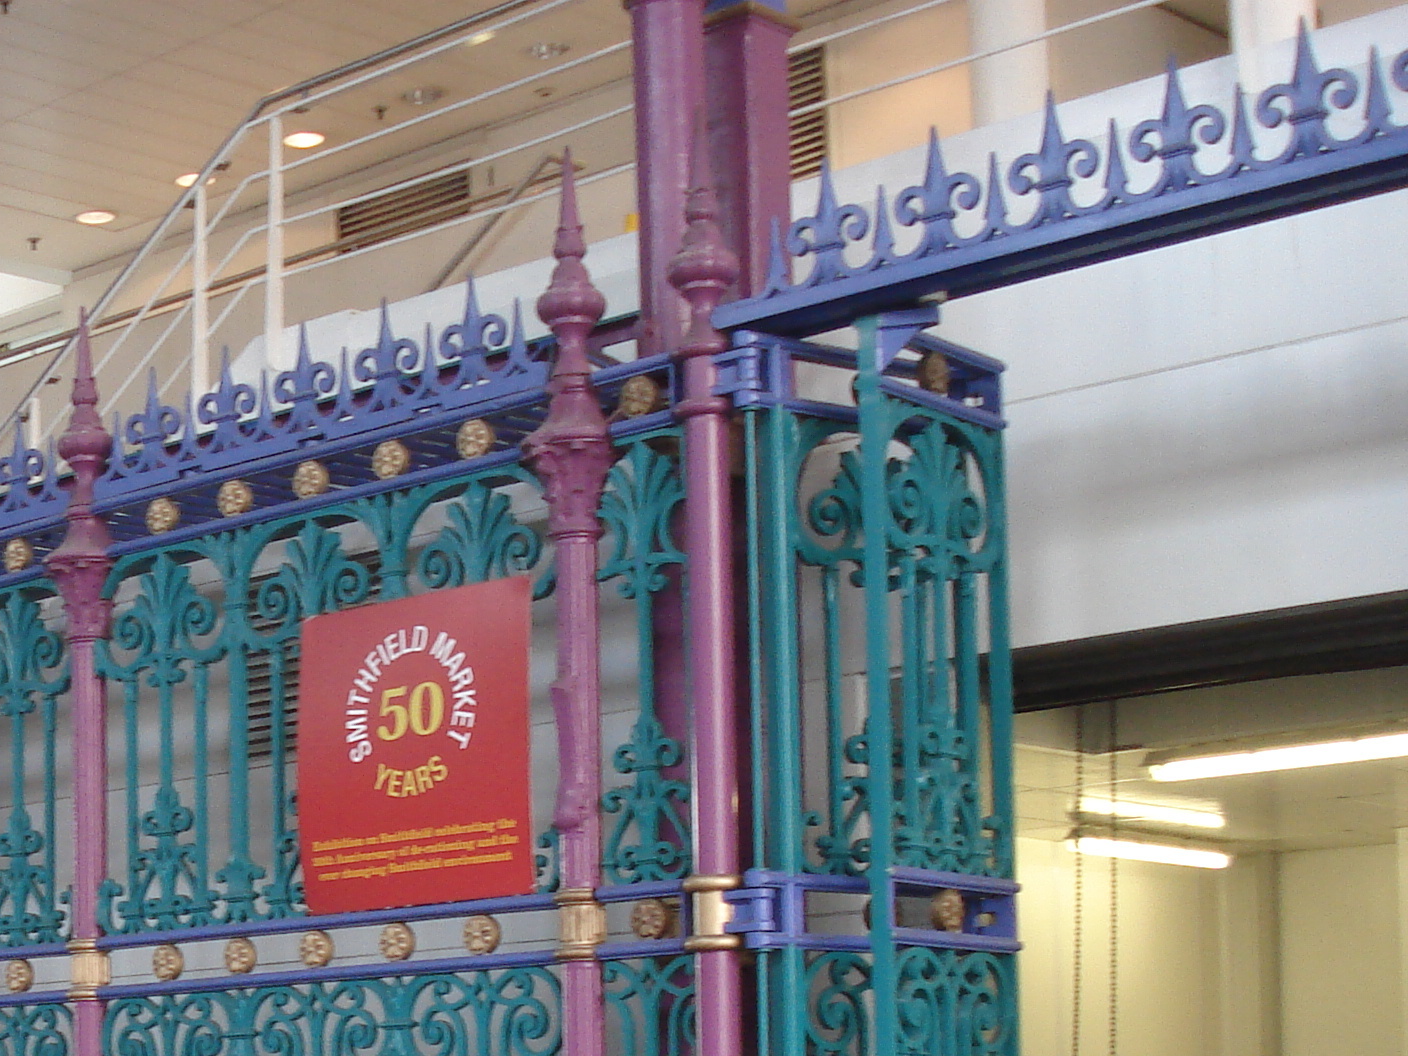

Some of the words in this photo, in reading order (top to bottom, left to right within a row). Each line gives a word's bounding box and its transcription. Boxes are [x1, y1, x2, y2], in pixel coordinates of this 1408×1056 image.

[345, 625, 429, 763] SMITHFIELD
[429, 631, 477, 749] MARKET
[376, 681, 445, 741] 50
[374, 755, 449, 798] YEARS
